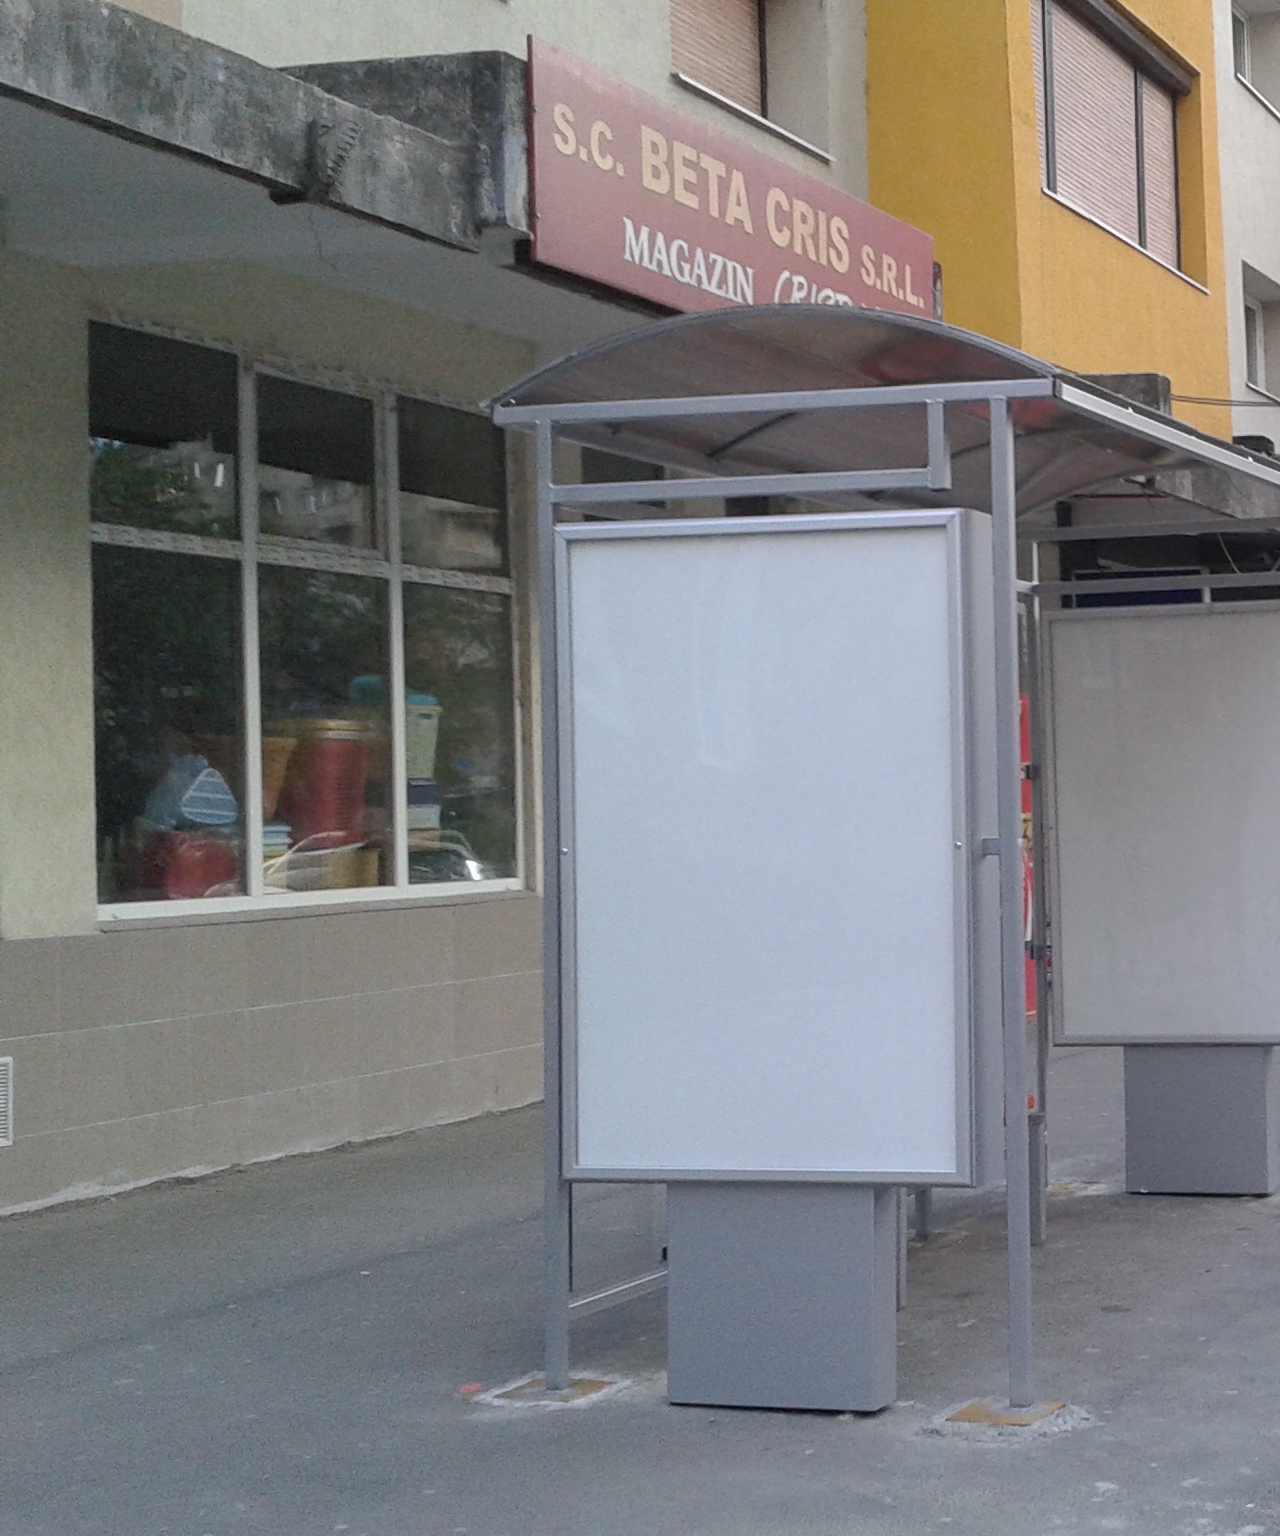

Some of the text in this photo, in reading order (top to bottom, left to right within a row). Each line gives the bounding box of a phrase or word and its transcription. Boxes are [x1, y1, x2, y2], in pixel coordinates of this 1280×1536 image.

[552, 102, 926, 309] S.C. BETA CRIS S.R.L.
[622, 216, 755, 306] MAGAZIN
